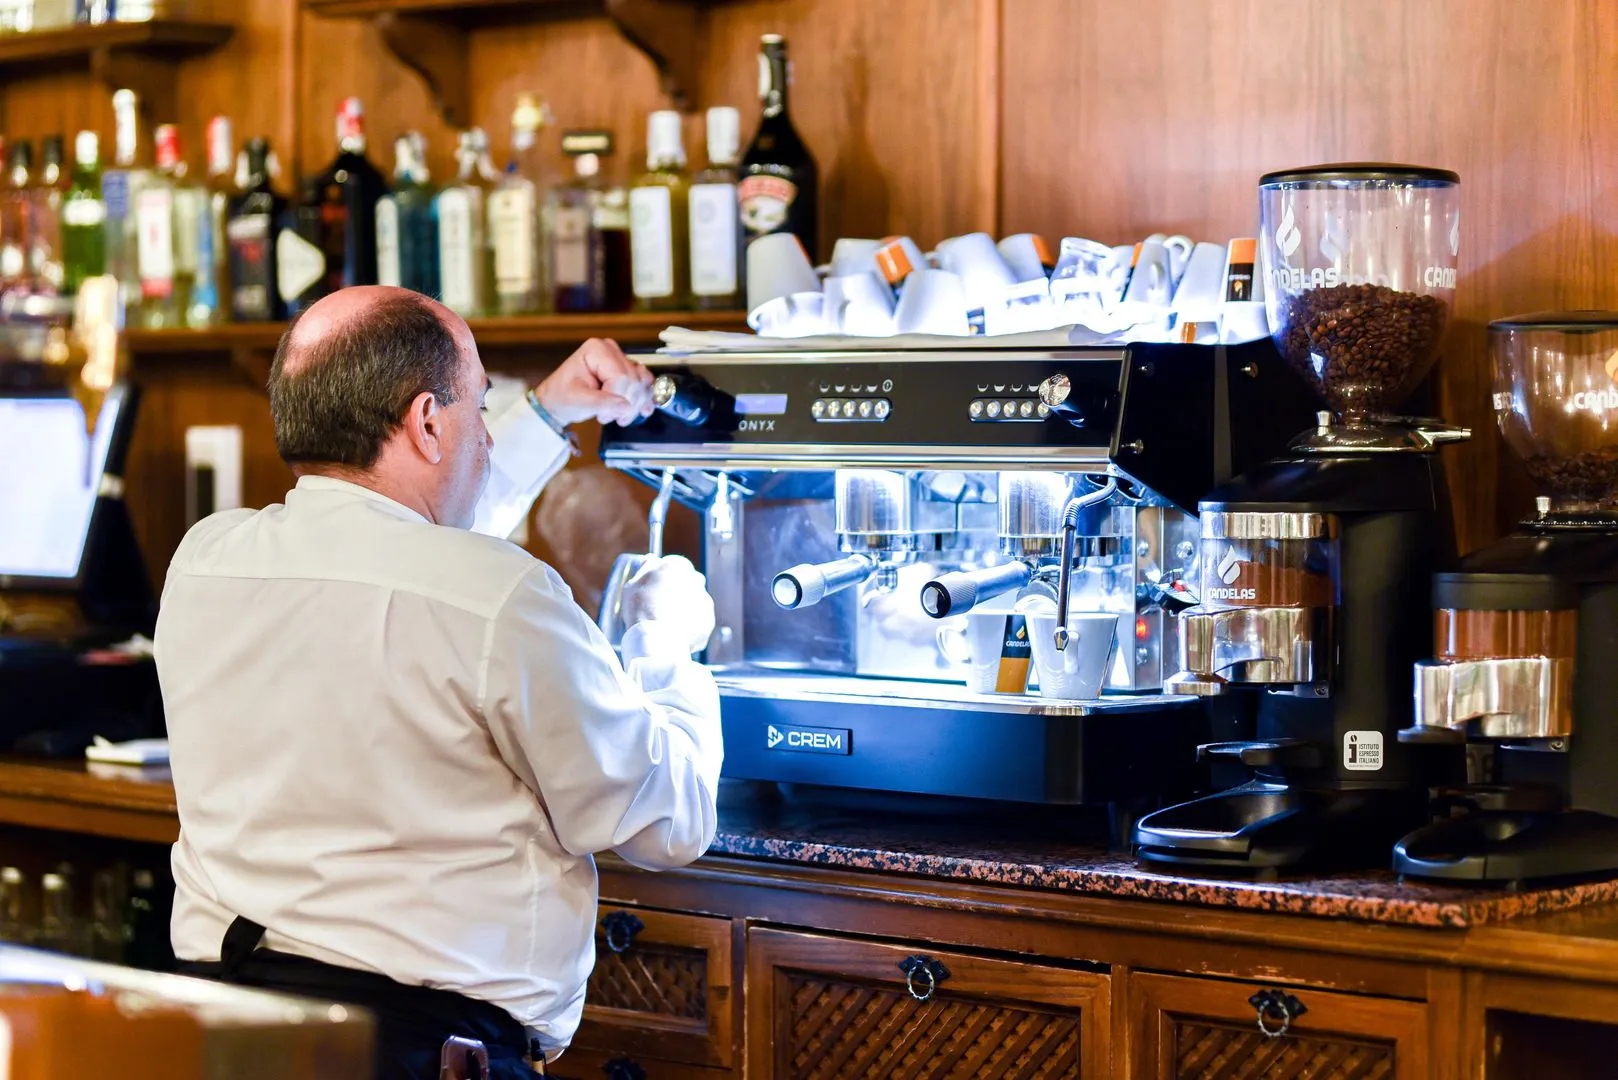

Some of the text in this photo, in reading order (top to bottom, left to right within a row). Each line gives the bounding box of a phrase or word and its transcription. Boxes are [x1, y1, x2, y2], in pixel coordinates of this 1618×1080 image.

[738, 419, 776, 431] ONYX
[1209, 587, 1256, 600] CANDELAS
[787, 731, 841, 749] CREM
